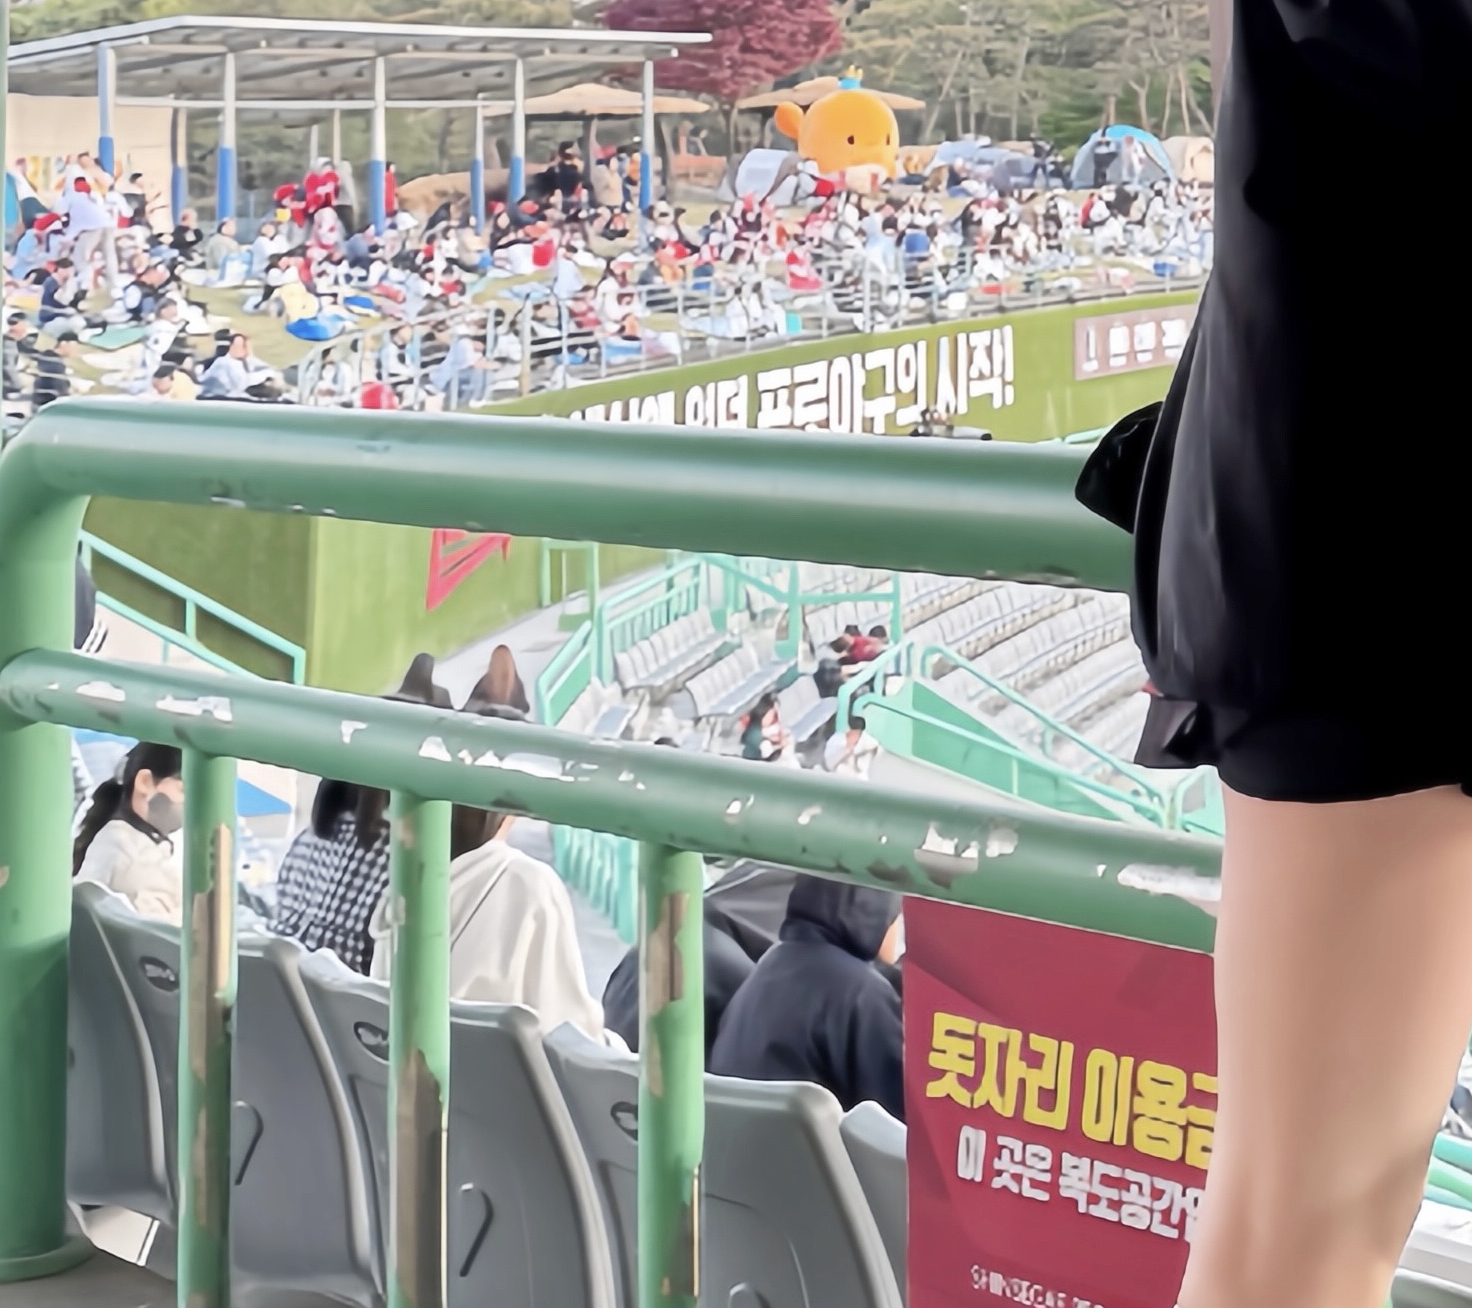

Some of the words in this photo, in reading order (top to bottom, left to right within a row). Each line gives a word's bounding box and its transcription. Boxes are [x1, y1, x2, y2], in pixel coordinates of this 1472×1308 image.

[925, 1010, 1075, 1131] 돗자리
[956, 1124, 987, 1183] 이
[991, 1134, 1054, 1202] 곳은
